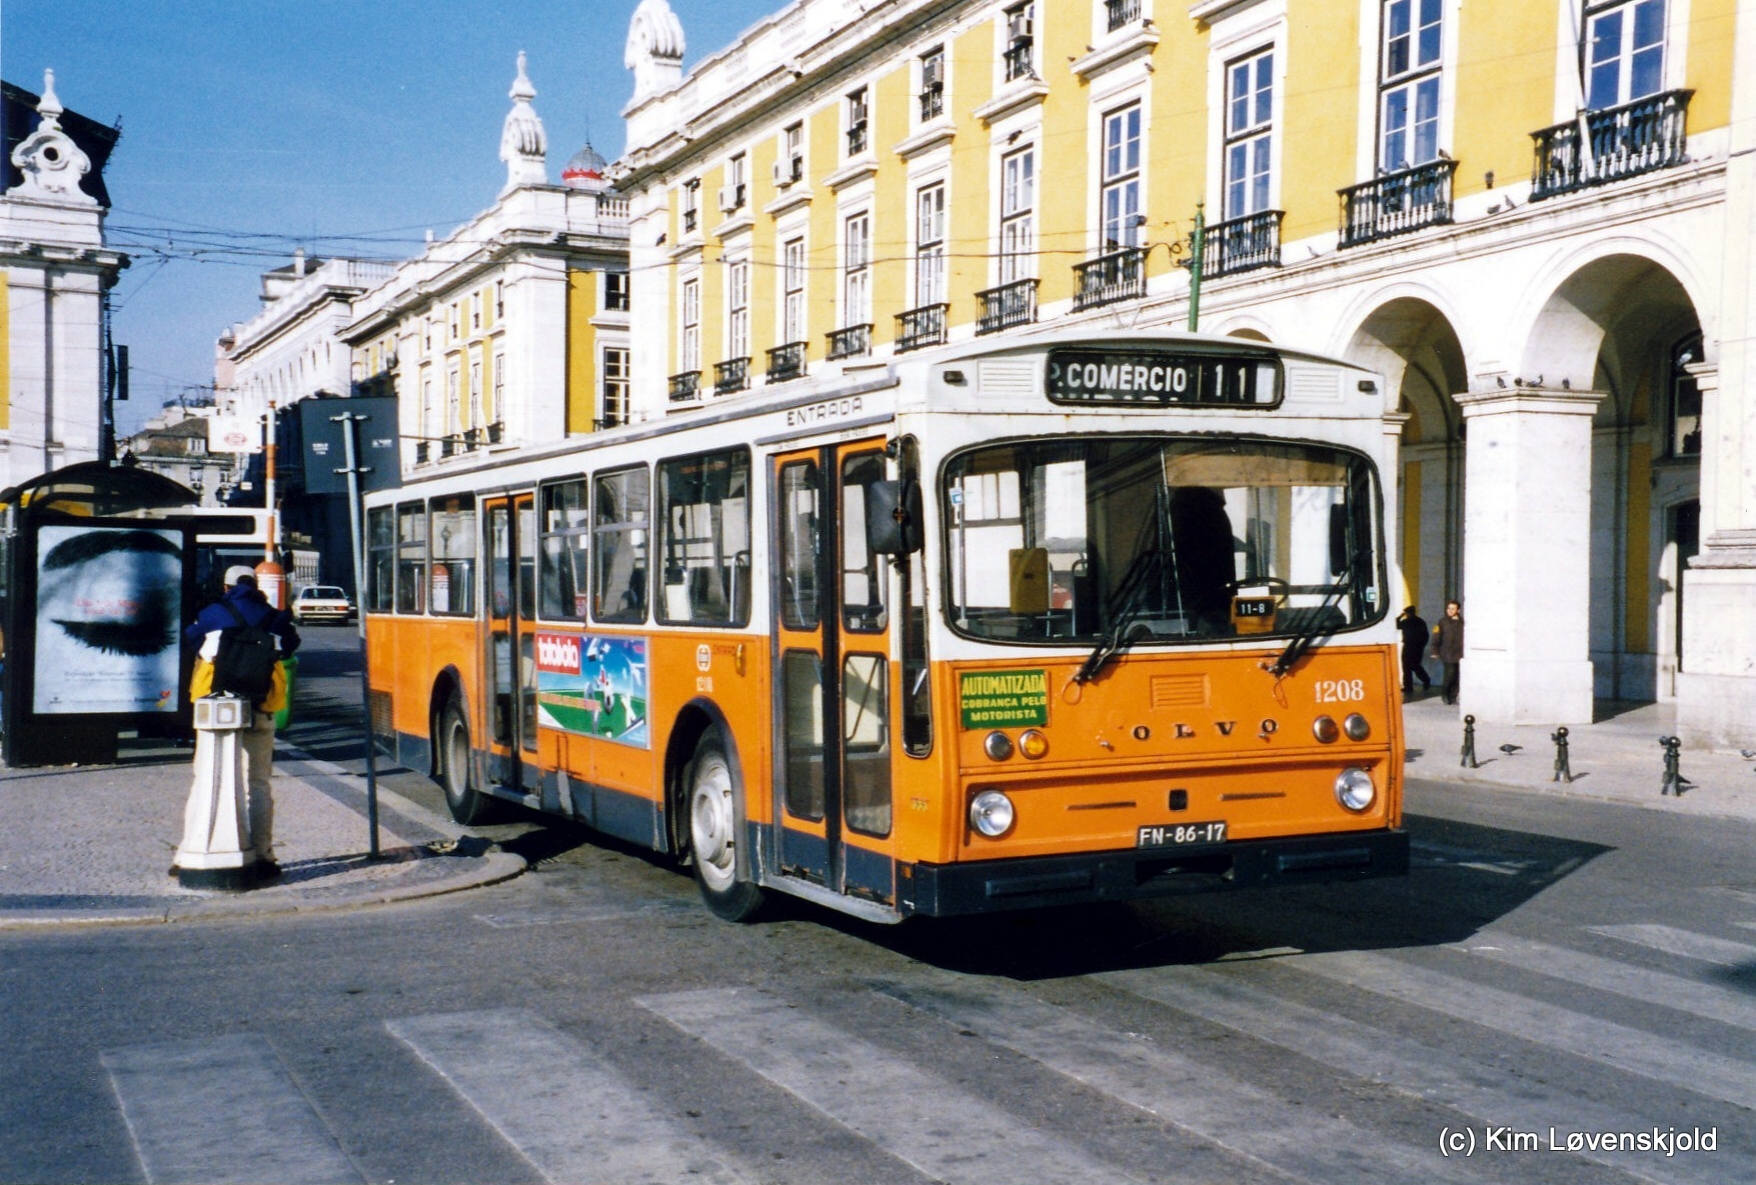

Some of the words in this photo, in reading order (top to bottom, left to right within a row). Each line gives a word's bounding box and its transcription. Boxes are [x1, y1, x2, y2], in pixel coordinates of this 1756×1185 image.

[1066, 362, 1187, 393] COMÉRCIO
[787, 396, 862, 426] ENTRADA
[1241, 603, 1266, 615] 11-8
[538, 636, 579, 669] totobola
[961, 674, 1046, 696] AUTOMATIZADA
[1314, 679, 1365, 704] 1208
[961, 697, 1019, 710] COBRANÇA
[1021, 695, 1047, 707] PELO
[970, 709, 1037, 722] MOTORISTA
[1140, 823, 1226, 846] FN-86-17
